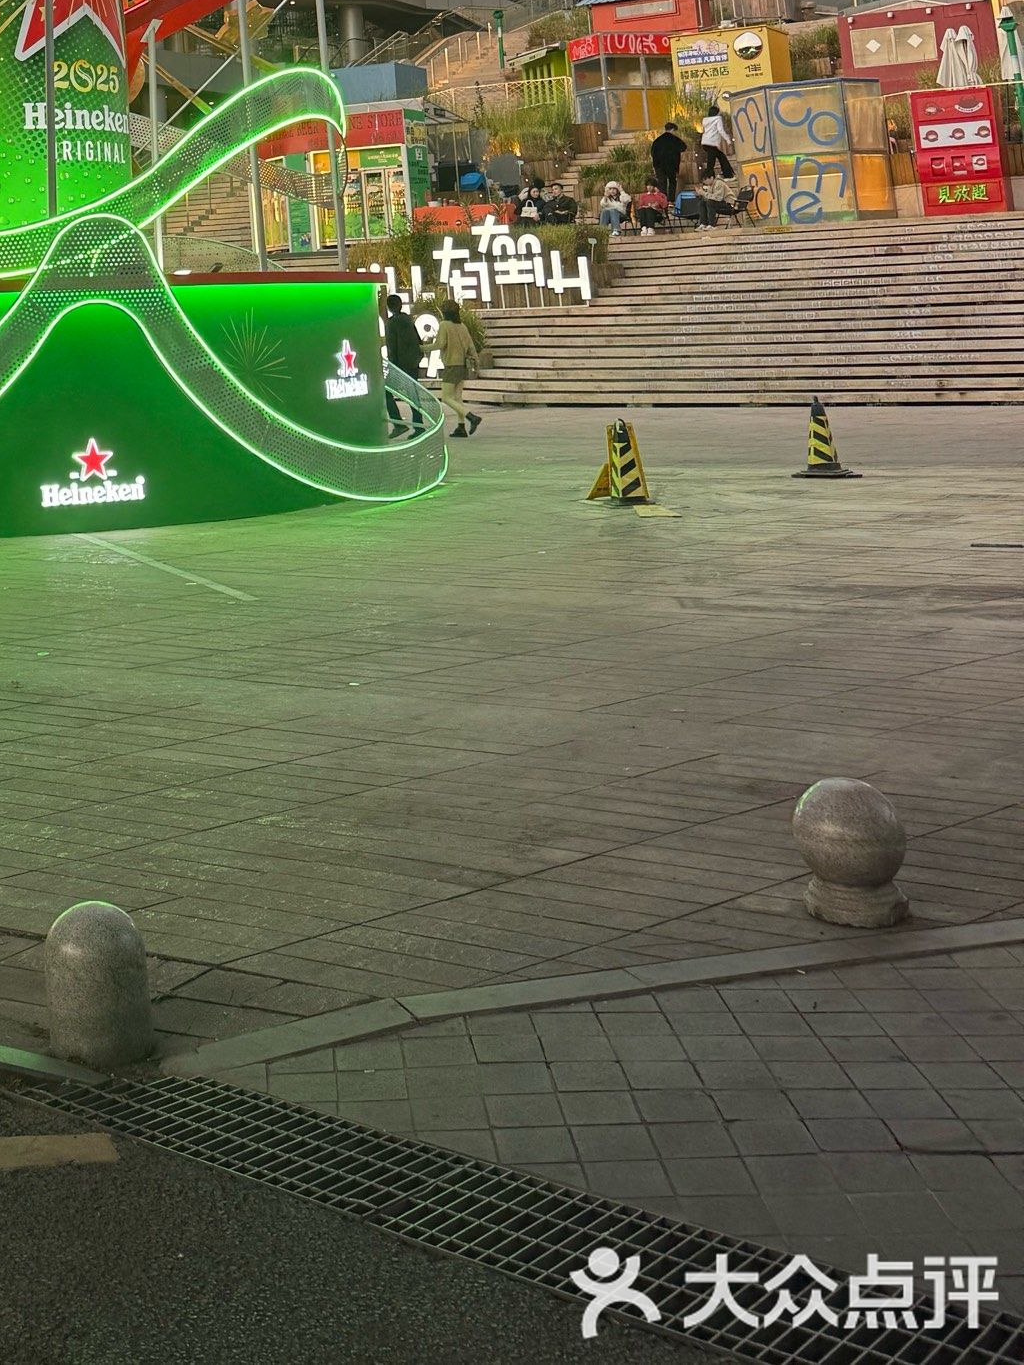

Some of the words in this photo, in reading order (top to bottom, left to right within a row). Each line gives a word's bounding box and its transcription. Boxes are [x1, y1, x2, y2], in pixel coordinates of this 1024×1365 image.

[52, 59, 120, 94] 2025
[55, 140, 126, 164] RIGINAL
[938, 184, 990, 204] 見放題
[40, 478, 146, 508] Heineken
